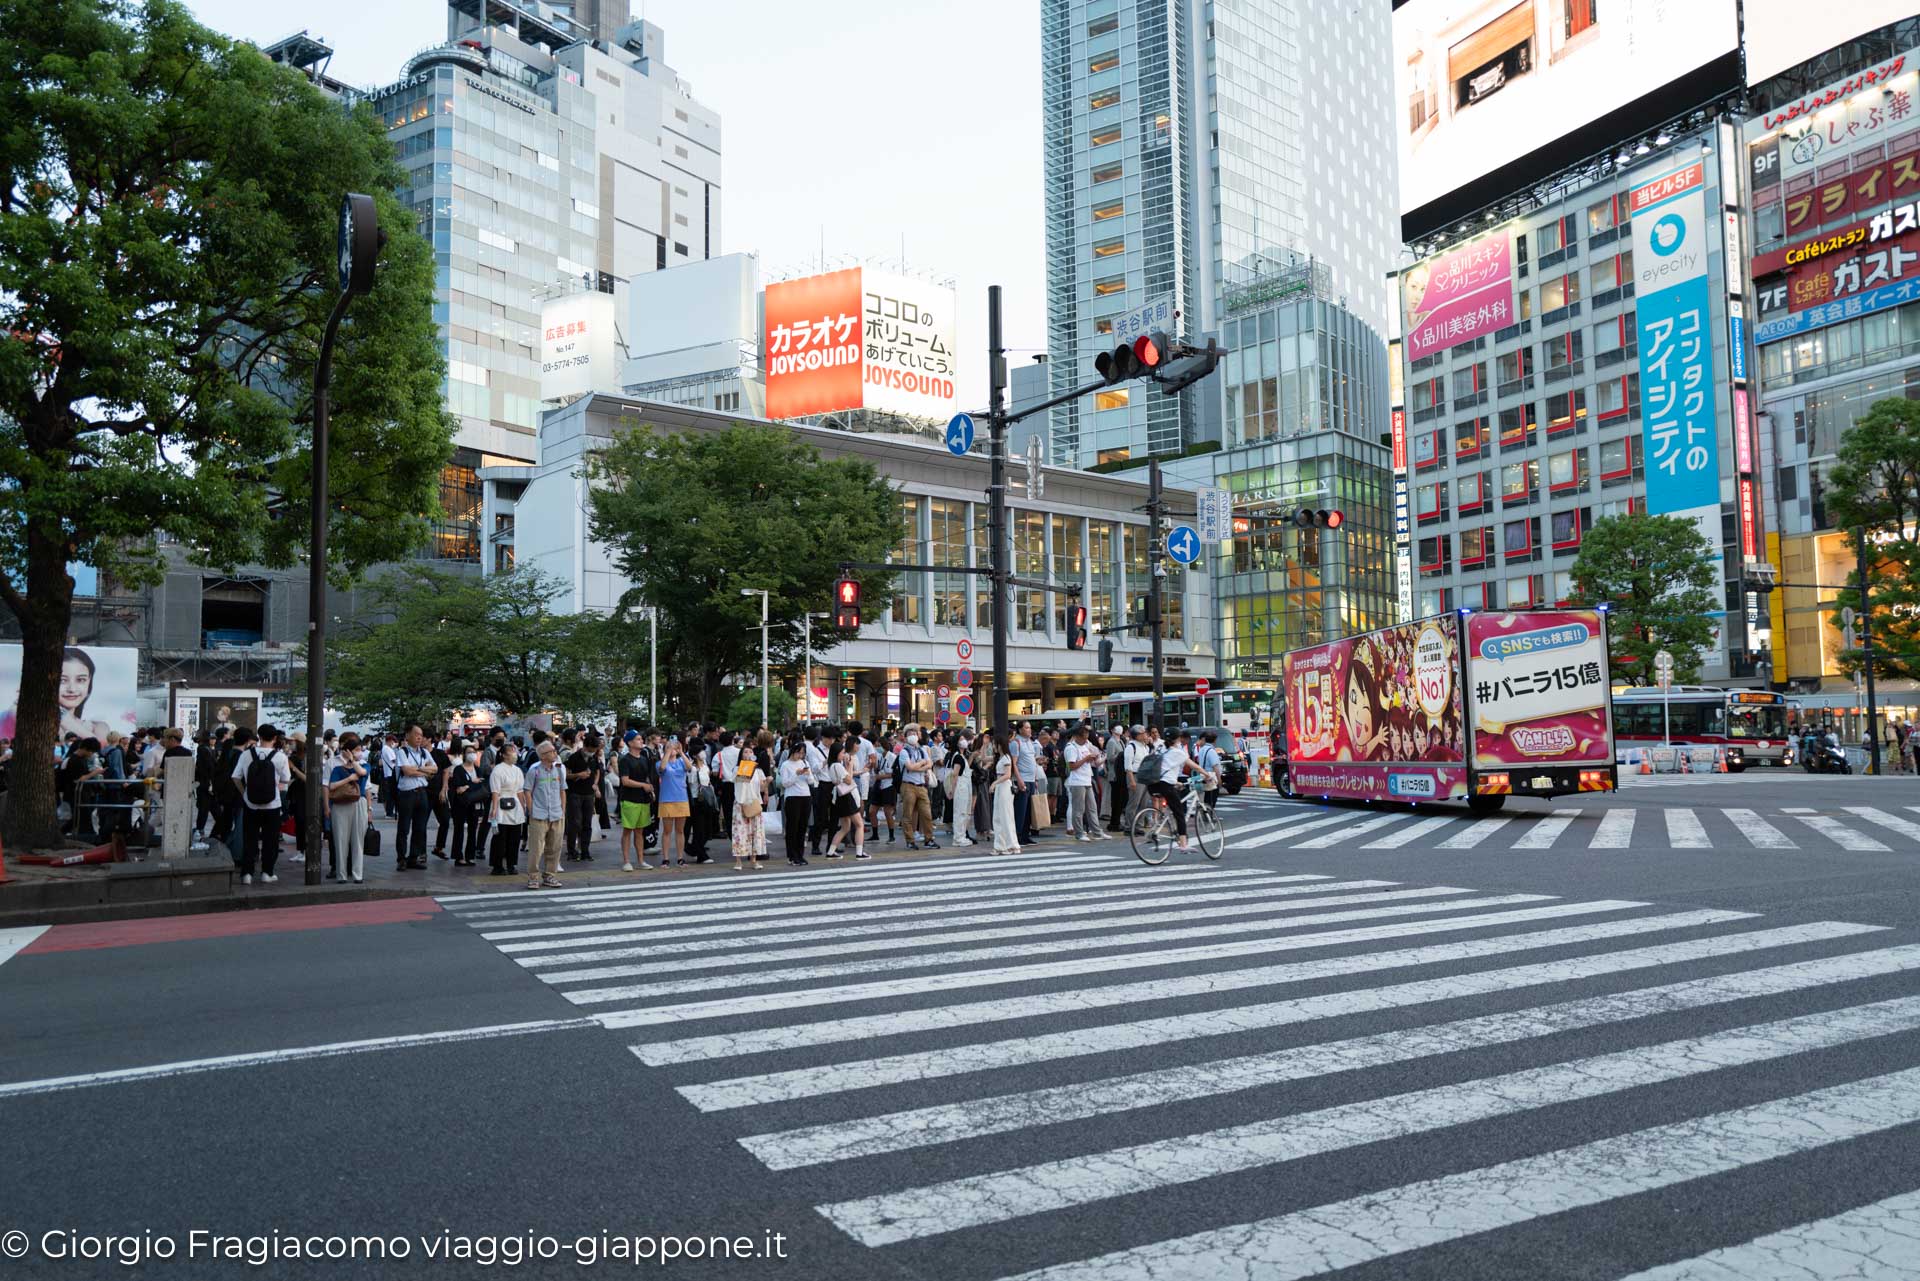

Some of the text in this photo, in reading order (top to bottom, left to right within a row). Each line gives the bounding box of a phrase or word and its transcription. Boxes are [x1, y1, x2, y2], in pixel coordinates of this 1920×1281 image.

[1763, 56, 1905, 129] しゃぶしゃぶバイキング
[1828, 91, 1912, 145] しゃぶ葉
[1754, 151, 1777, 173] 9F
[1637, 168, 1696, 206] 当ビル5F
[1787, 156, 1920, 227] プライス
[1448, 242, 1505, 277] 品川スキン
[1450, 261, 1500, 293] クリニック
[1642, 252, 1697, 283] eyecity
[1833, 246, 1917, 297] ガスト
[865, 292, 933, 327] ココロの
[1759, 287, 1787, 311] 7F
[545, 320, 586, 342] 広告募集
[770, 313, 858, 354] カラオケ
[865, 318, 953, 357] ボリューム、
[1116, 302, 1168, 338] 渋谷駅前
[1422, 298, 1508, 347] 品川美容外科
[1760, 317, 1797, 339] AEON
[770, 344, 860, 376] JOYSOUND
[865, 343, 955, 376] あげていこう。
[864, 363, 954, 400] JOYSOUND
[1645, 316, 1681, 476] アイシティ
[1680, 308, 1709, 471] コンタクトの
[1205, 491, 1216, 540] 渋谷駅前
[1420, 674, 1445, 701] No.1
[1476, 662, 1602, 705] #バニラ15億
